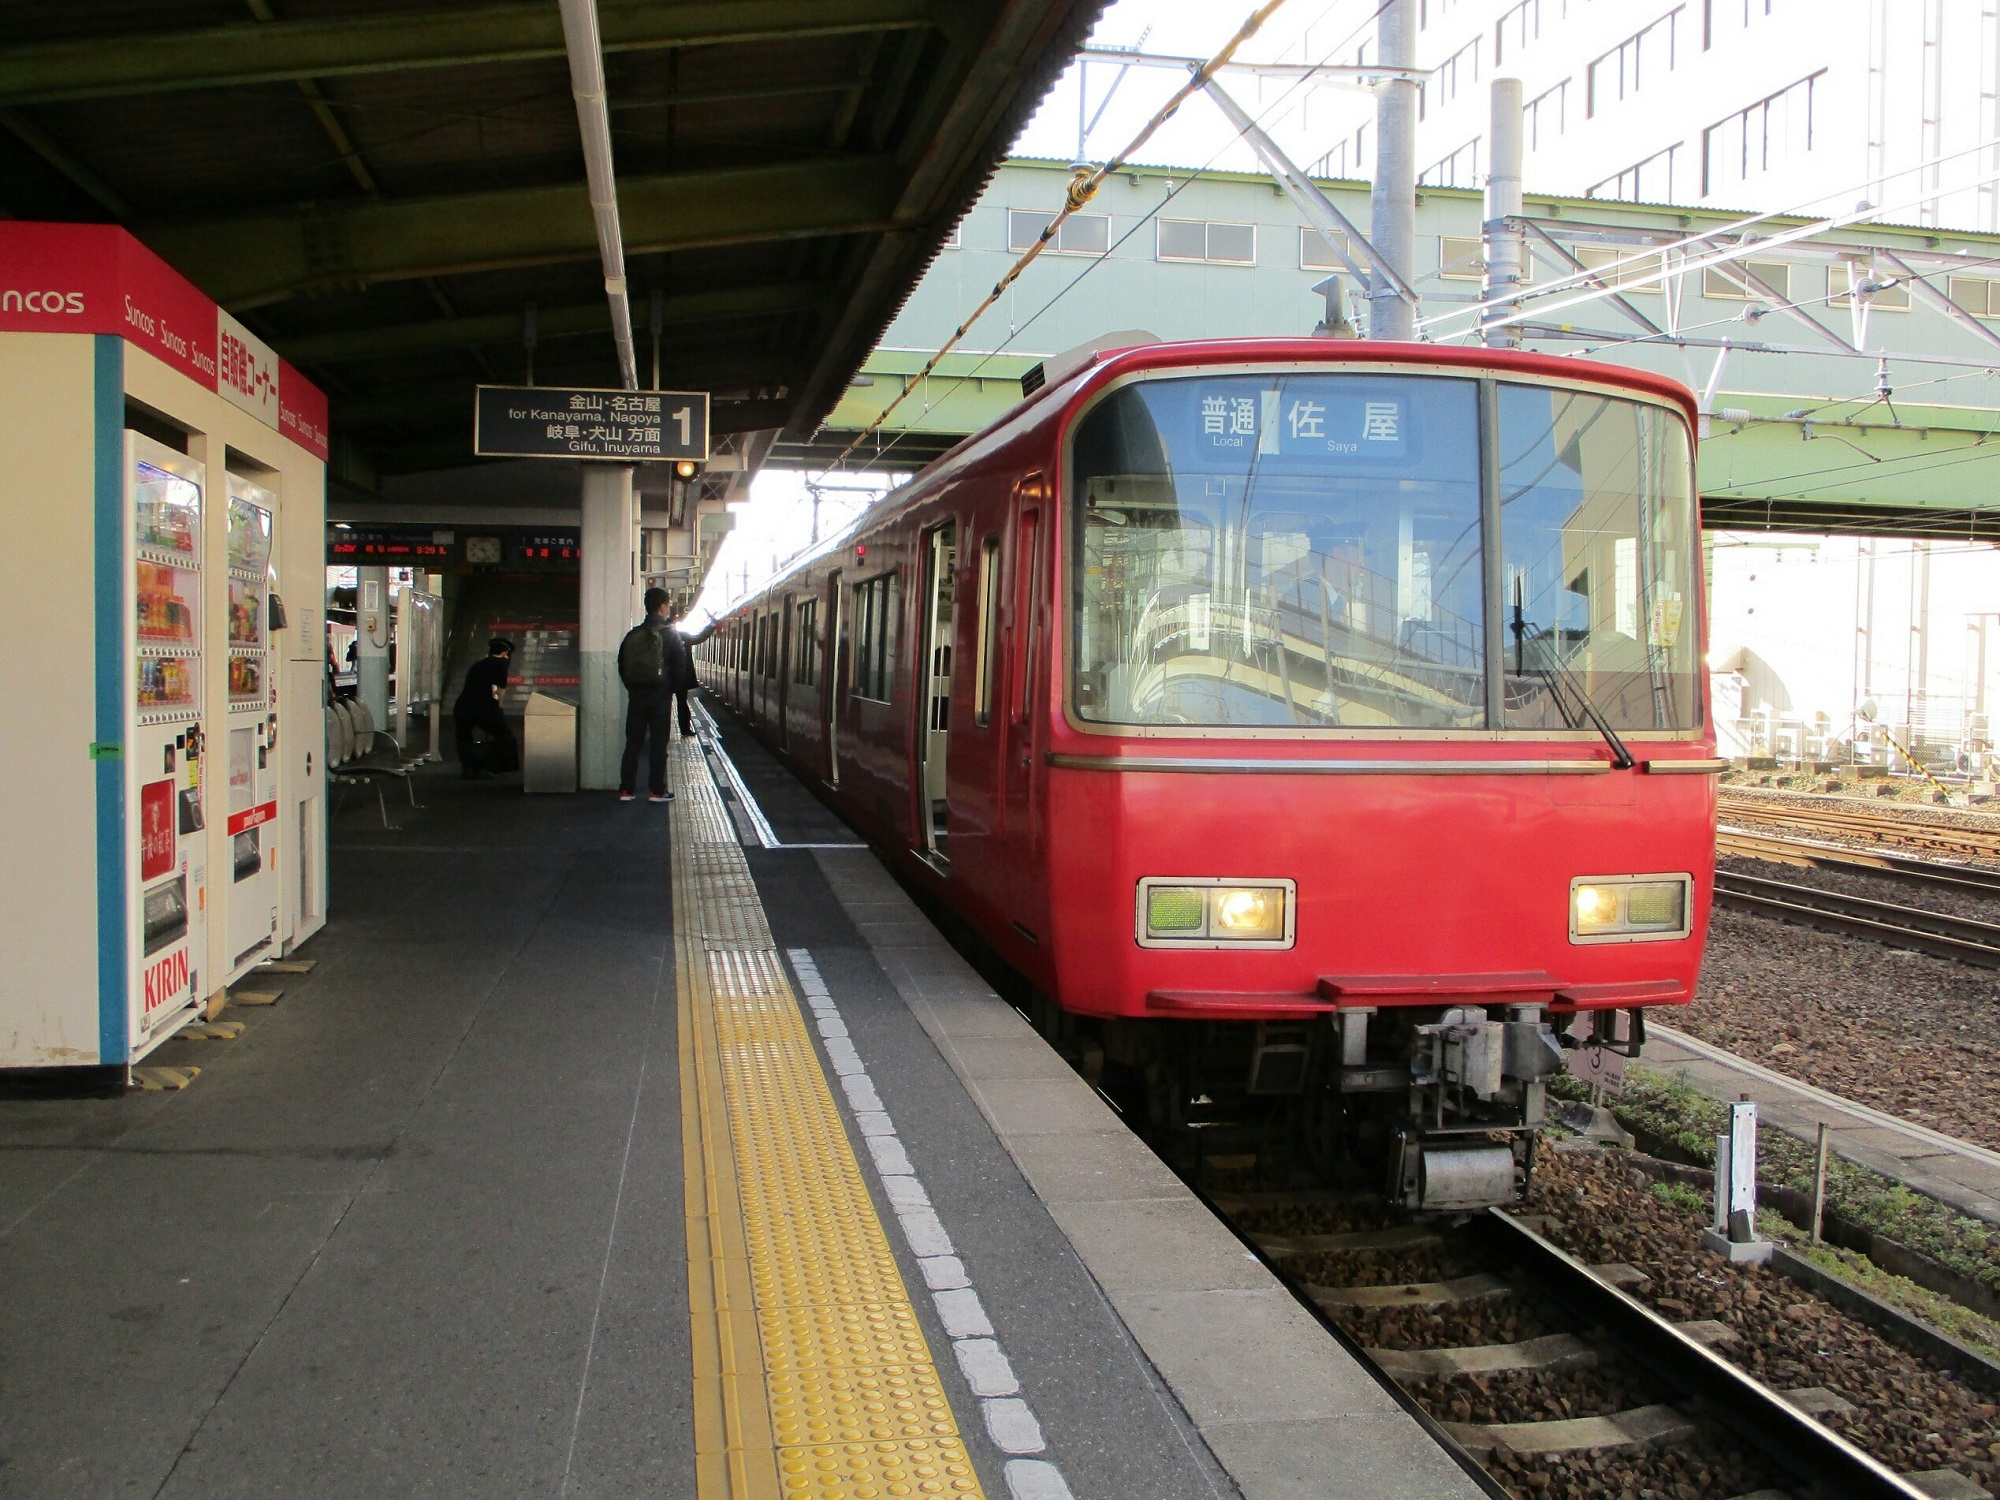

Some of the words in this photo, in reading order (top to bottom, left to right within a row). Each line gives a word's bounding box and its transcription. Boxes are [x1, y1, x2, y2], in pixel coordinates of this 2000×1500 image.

[125, 294, 155, 337] Suncos
[160, 319, 187, 358] Suncos
[191, 341, 215, 376] Suncos
[221, 329, 277, 405] 自販機コーナー
[569, 394, 661, 412] 金山・名古屋
[509, 409, 527, 420] for
[530, 409, 606, 423] Kanayama,
[610, 412, 661, 425] Nagoya
[1202, 396, 1255, 435] 普通
[627, 427, 661, 442] 方面
[672, 406, 691, 446] 1
[569, 440, 600, 453] Gifu,
[604, 442, 661, 455] Inuyama
[1213, 435, 1243, 447] Local
[1327, 441, 1357, 454] Saya
[144, 946, 189, 1013] KIRIN
